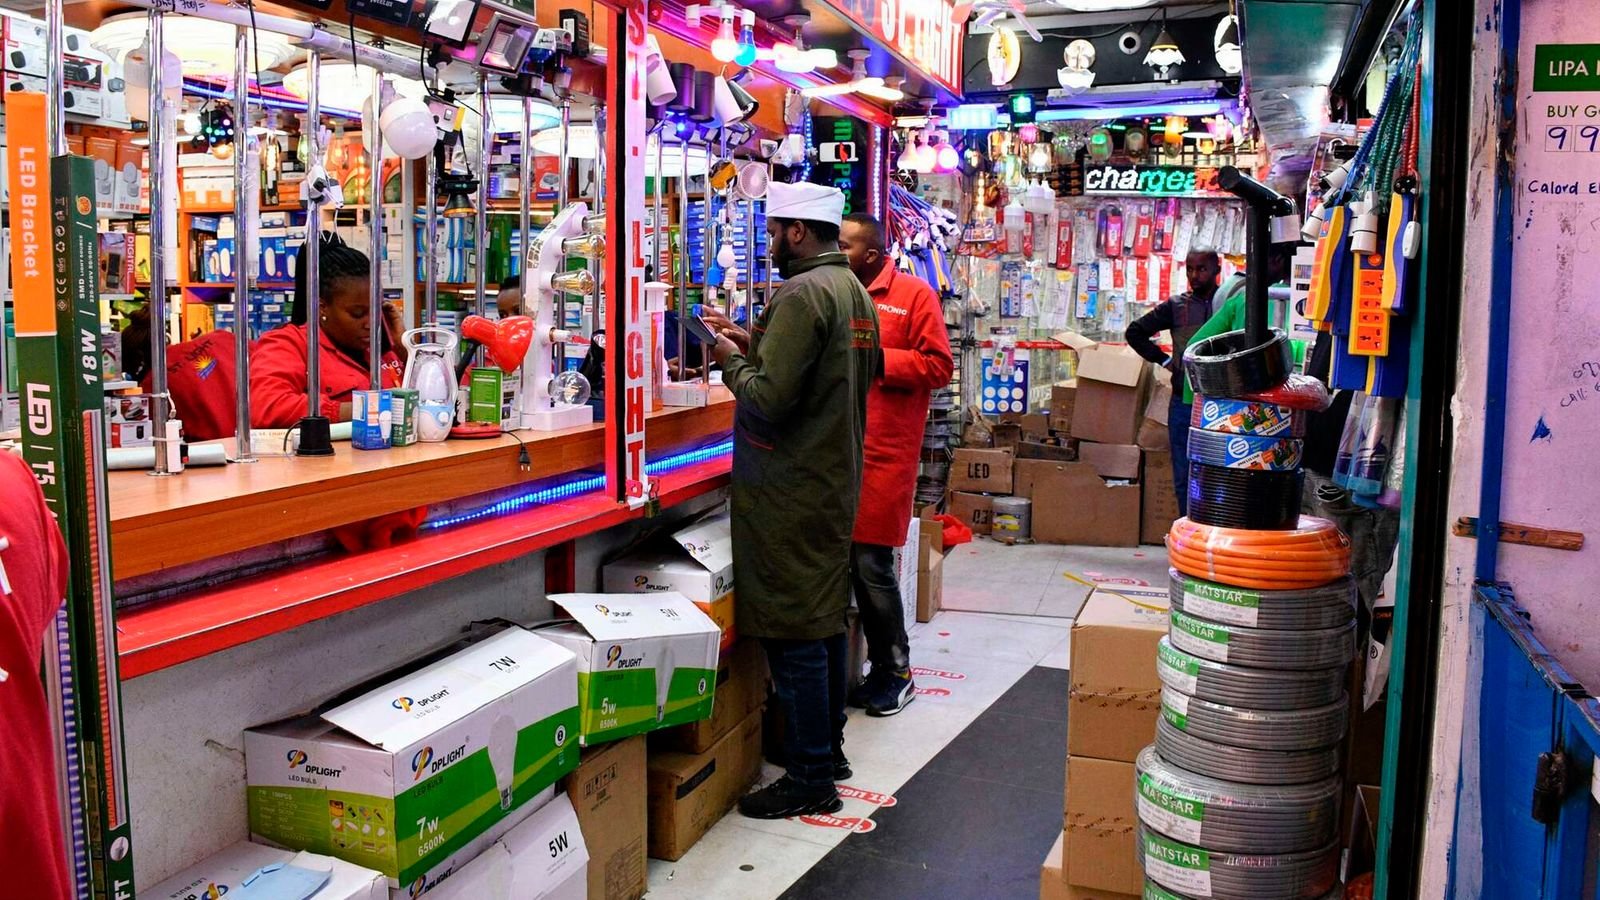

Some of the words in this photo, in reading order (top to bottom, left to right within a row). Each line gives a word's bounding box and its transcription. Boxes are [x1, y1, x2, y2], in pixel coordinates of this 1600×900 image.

[1549, 60, 1589, 77] LIPA
[1546, 105, 1579, 118] BUY
[1584, 105, 1600, 118] G
[19, 147, 35, 188] LED
[1528, 179, 1579, 195] Calord
[23, 197, 39, 278] Bracket
[127, 235, 135, 275] DIGITAL
[877, 303, 908, 316] TRONIC
[81, 329, 97, 386] 18W
[627, 220, 645, 482] LIGHT
[26, 383, 53, 435] LED
[32, 460, 56, 486] T5
[967, 463, 990, 479] LED
[1194, 583, 1243, 603] MATSTAR
[488, 655, 517, 671] 7W
[618, 657, 643, 669] DPLIGHT
[417, 688, 450, 707] DPLIGHT
[305, 764, 342, 778] DPLIGHT
[431, 745, 466, 774] DPLIGHT
[1142, 782, 1194, 815] MATSTAR
[417, 831, 446, 858] 6500K
[548, 831, 569, 858] 5W
[1149, 840, 1201, 866] MATSTAR
